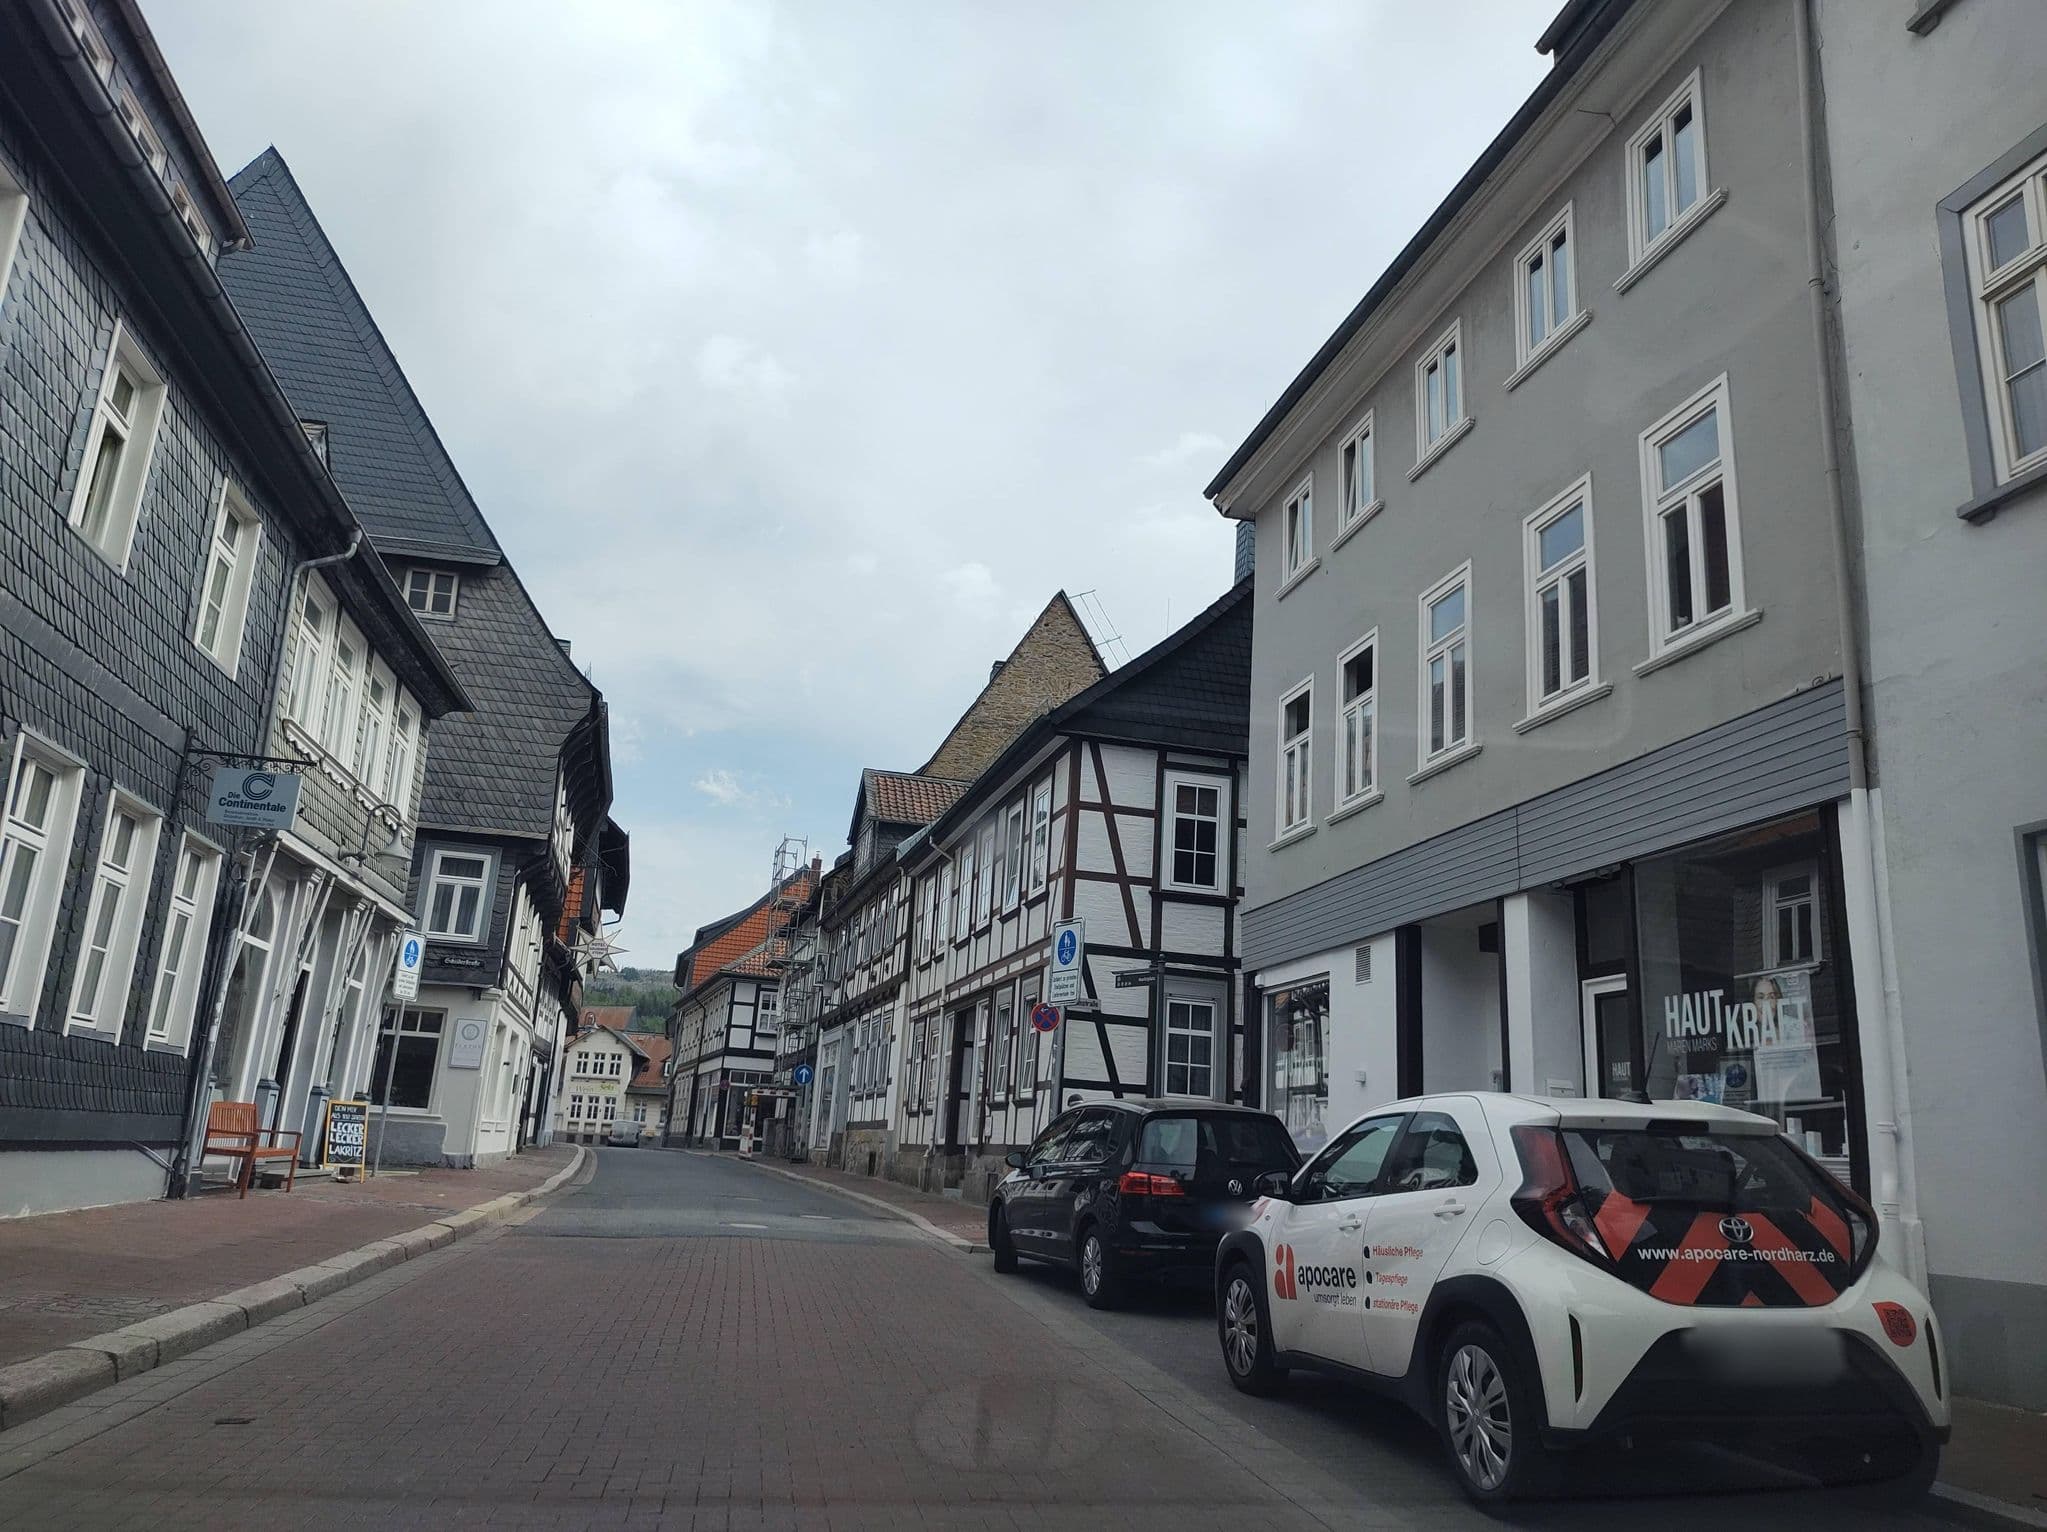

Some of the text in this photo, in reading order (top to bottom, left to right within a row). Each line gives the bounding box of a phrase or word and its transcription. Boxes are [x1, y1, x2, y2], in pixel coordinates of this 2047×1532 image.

[227, 791, 241, 799] Die
[218, 797, 287, 813] Continentale
[1664, 989, 1806, 1051] HAUT KRAFT
[1666, 1036, 1718, 1054] MAREN MARKS
[330, 1121, 364, 1135] LECKER
[329, 1132, 363, 1145] LECKER
[328, 1144, 363, 1157] LAKRITZ
[1373, 1246, 1423, 1259] Häusliche Pflege
[1637, 1247, 1835, 1263] www.apocare-nordharz.de
[1298, 1265, 1357, 1292] apocare
[1375, 1272, 1408, 1286] Tagespflege
[1313, 1292, 1357, 1307] umsorgt leben
[1373, 1299, 1419, 1314] stationäre Pflege
